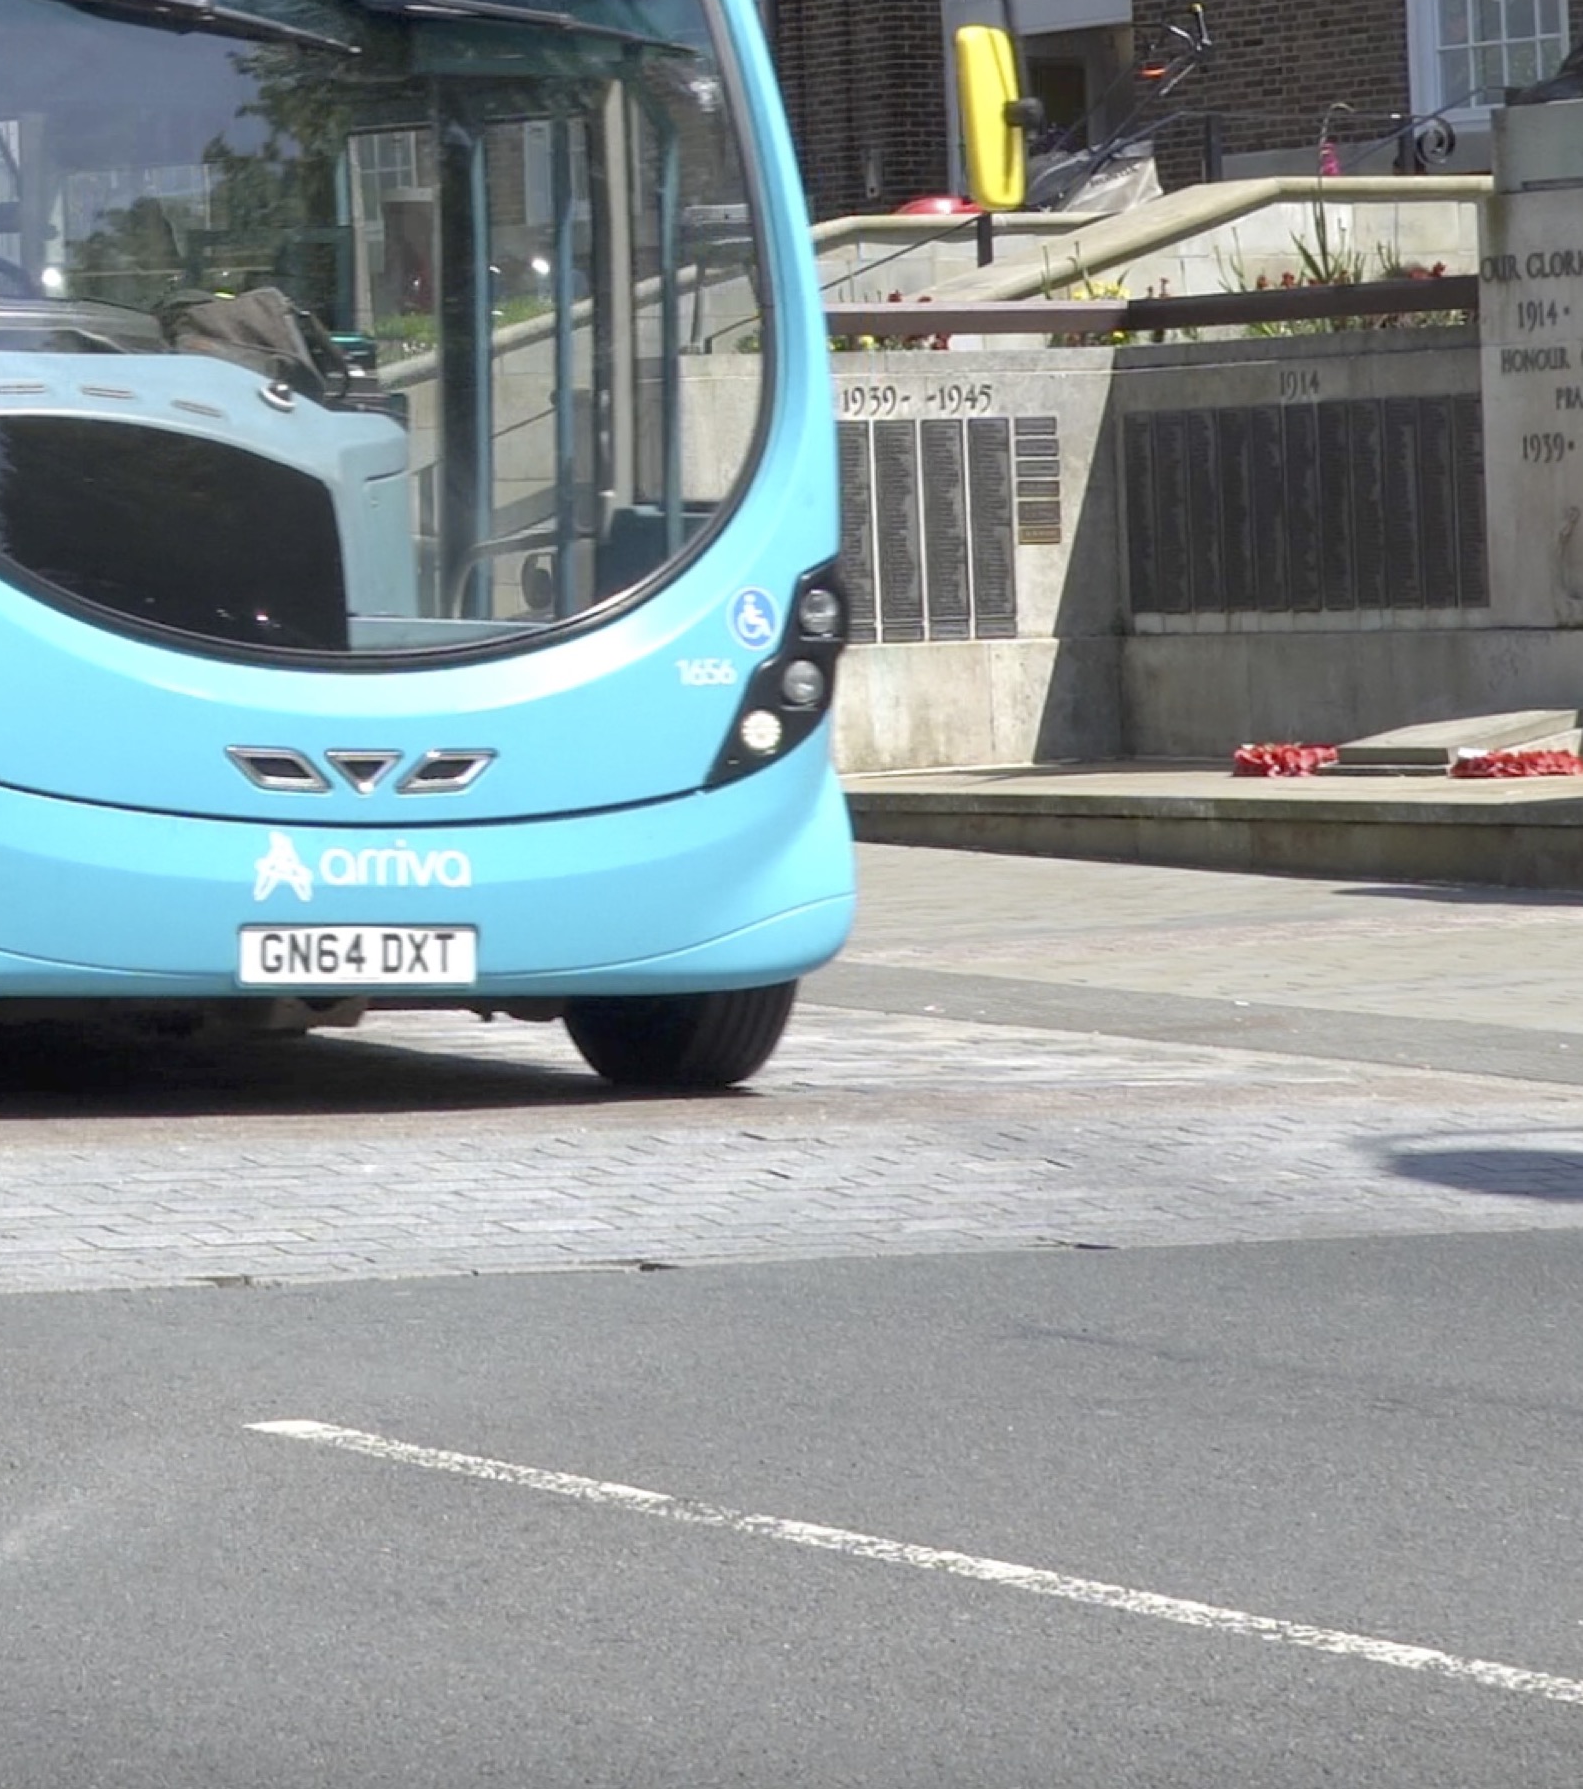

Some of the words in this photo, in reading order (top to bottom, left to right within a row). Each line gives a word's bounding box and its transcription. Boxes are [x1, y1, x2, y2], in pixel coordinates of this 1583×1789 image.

[1480, 254, 1523, 283] OUR
[1500, 346, 1571, 374] HONOUR
[1279, 368, 1321, 401] 1914
[675, 658, 738, 686] 1656
[319, 838, 473, 889] arriva
[260, 932, 366, 974] GN64
[381, 932, 455, 974] DXT
